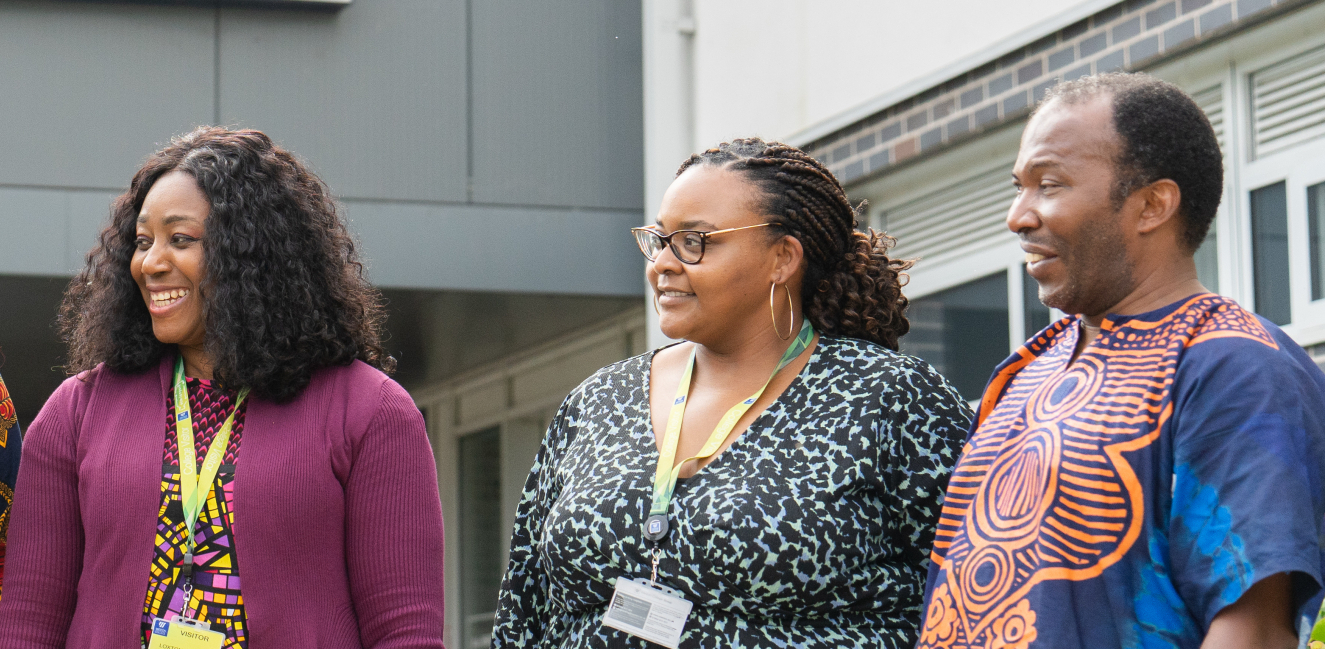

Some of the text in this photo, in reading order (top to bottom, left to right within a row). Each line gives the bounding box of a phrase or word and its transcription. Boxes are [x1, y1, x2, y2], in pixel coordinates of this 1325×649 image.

[181, 427, 190, 447] Visitor
[715, 409, 742, 440] College
[206, 422, 232, 472] College Visitor
[183, 448, 194, 475] College
[180, 630, 210, 642] VISITOR
